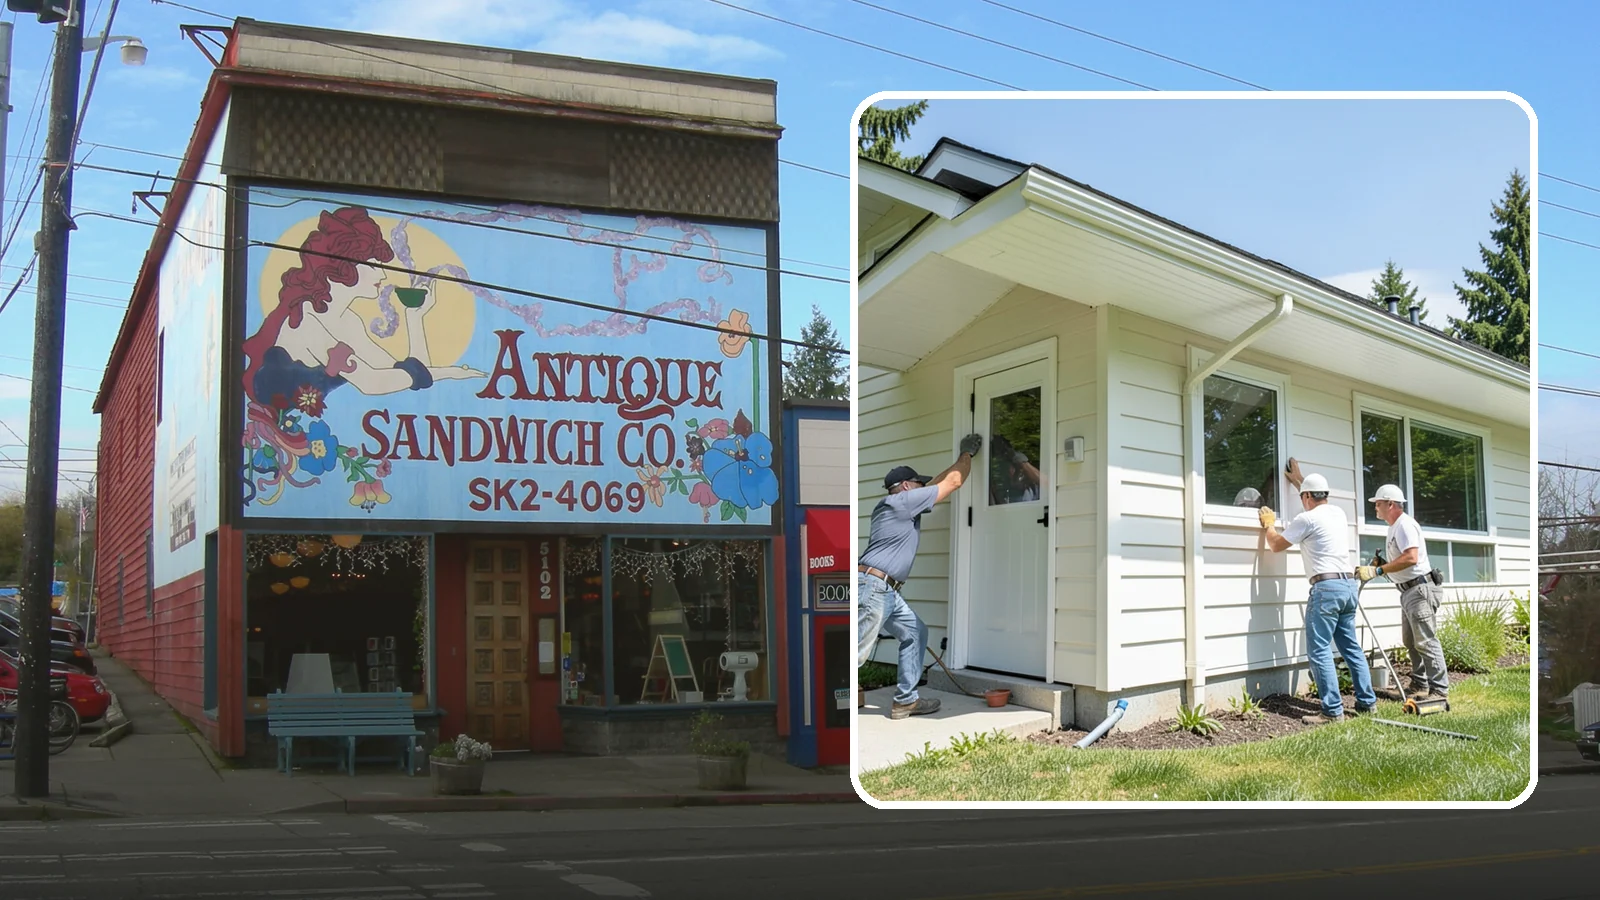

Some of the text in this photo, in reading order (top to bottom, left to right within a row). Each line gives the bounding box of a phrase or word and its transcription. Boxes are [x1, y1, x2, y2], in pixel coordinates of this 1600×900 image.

[476, 330, 723, 420] ANTIQUE
[361, 409, 685, 469] SANDWICH CO.
[468, 478, 646, 513] SK2-4069
[540, 542, 551, 599] 5102
[809, 555, 834, 569] BOOKS
